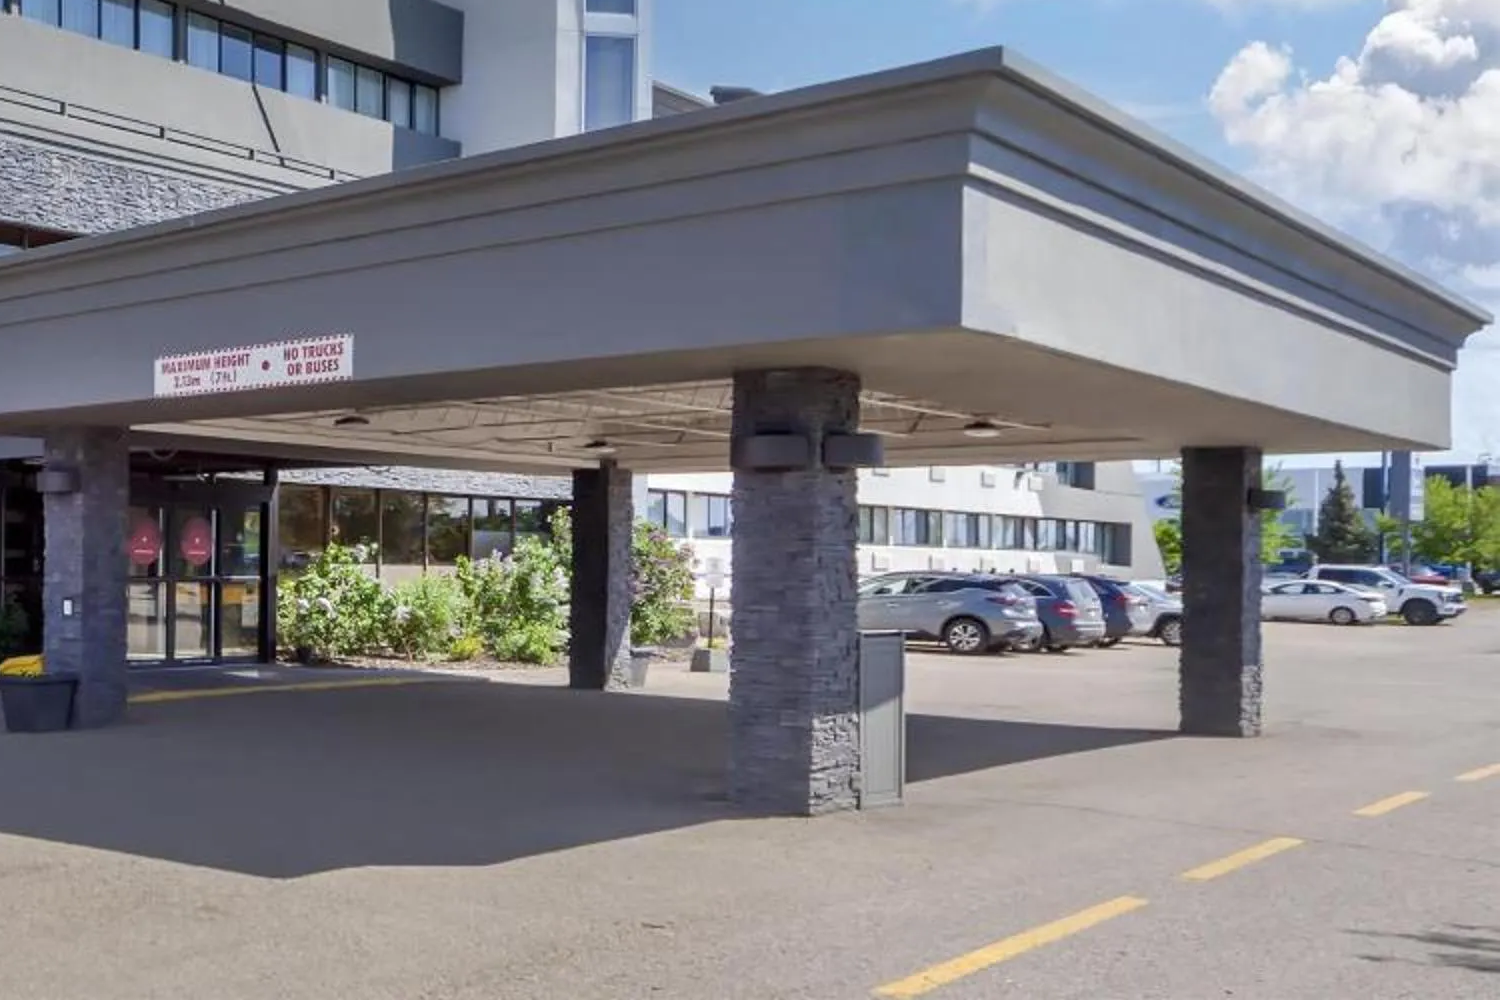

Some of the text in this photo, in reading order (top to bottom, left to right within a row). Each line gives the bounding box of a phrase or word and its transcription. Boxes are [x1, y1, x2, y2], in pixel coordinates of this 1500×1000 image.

[283, 341, 344, 361] NO TRUCKS
[161, 352, 250, 374] MAXIMUM HEIGHT
[287, 358, 339, 376] OR BUSES
